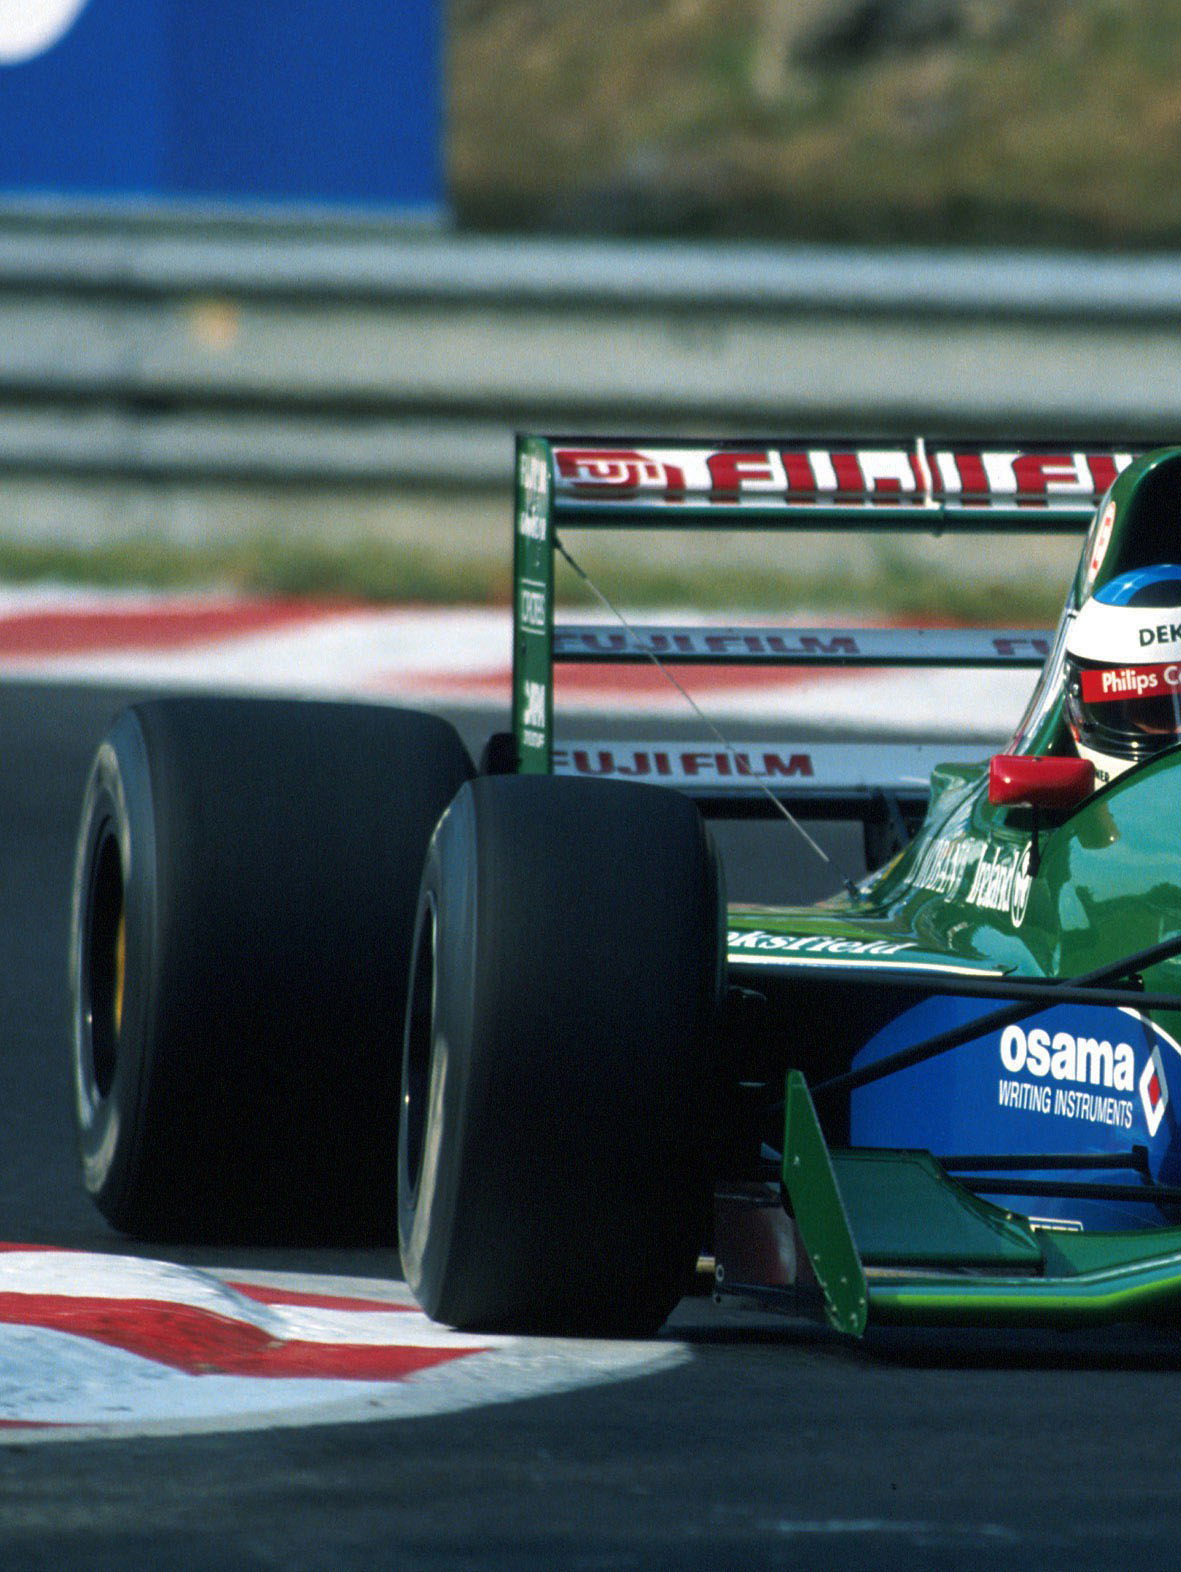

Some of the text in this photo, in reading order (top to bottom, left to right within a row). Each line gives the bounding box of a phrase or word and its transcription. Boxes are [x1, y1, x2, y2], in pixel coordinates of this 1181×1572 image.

[1102, 669, 1158, 695] Philips
[999, 1079, 1133, 1129] WRITING INSTRUMENTS
